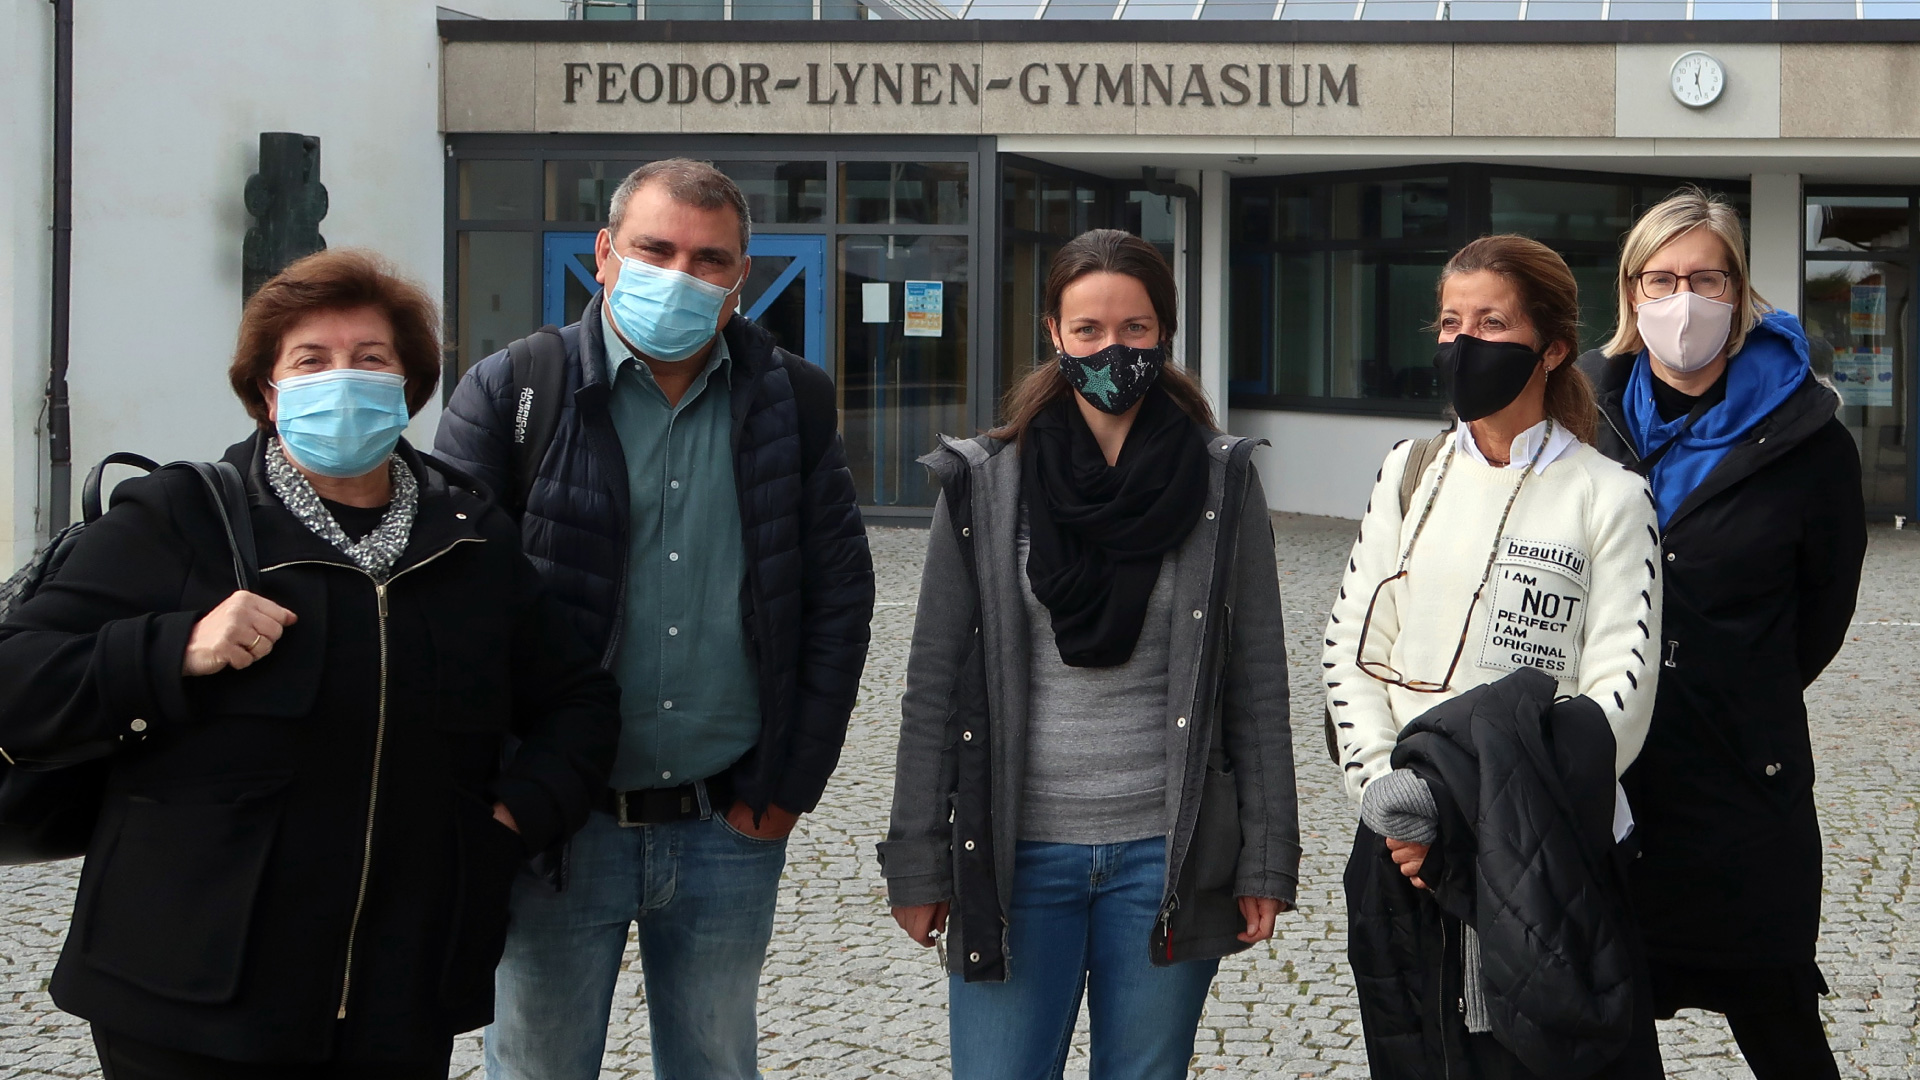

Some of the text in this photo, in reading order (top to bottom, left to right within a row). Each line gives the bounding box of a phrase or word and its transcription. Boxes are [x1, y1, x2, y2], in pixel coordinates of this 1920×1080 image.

[563, 63, 1360, 106] FEODOR-LYNEN-GYMNASIUM
[515, 387, 528, 443] TOURISTER
[519, 387, 534, 444] AMERICAN
[1508, 541, 1585, 573] beautiful
[1504, 569, 1537, 586] I AM
[1521, 588, 1580, 621] NOT
[1494, 622, 1527, 638] I AM
[1497, 609, 1568, 633] PERFECT
[1492, 636, 1566, 658] ORIGINAL
[1511, 653, 1565, 671] GUESS
